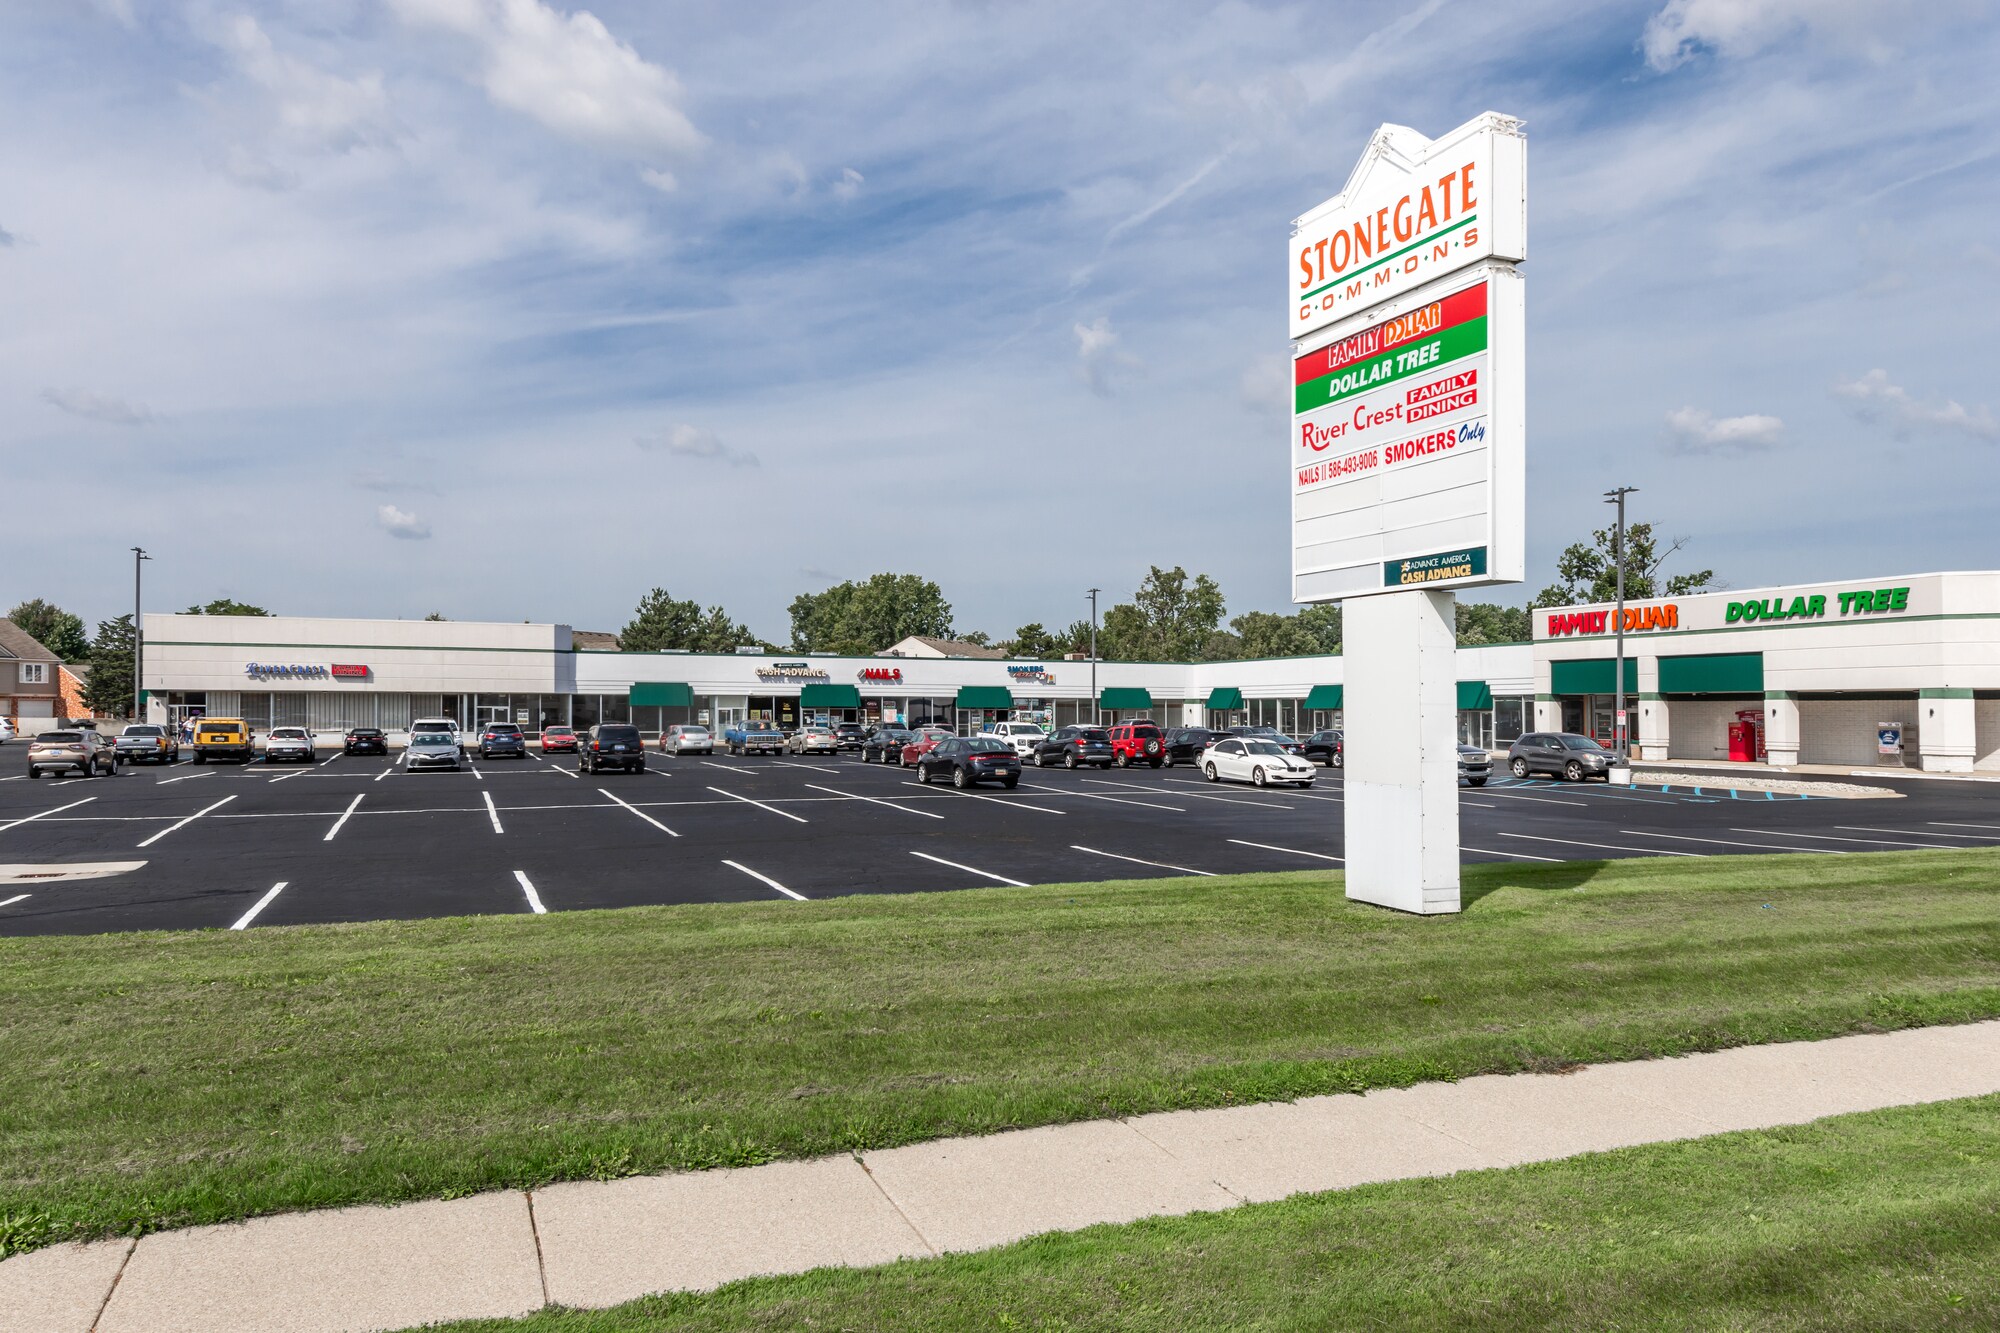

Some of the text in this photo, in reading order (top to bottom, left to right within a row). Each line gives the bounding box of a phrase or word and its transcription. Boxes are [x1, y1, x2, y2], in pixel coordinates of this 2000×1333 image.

[1300, 161, 1477, 289] STONEGATE
[1328, 302, 1441, 368] FAMILY DOLLAR
[1329, 341, 1441, 397] DOLLAR TREE
[1410, 372, 1473, 402] FAMILY
[1410, 392, 1473, 421] DINING
[1302, 402, 1403, 451] River Crest
[1384, 421, 1486, 465] SMOKERS Only
[1298, 466, 1320, 487] NAILS
[1328, 450, 1378, 478] 586-493-9006
[1401, 564, 1471, 584] CASH ADVANCE
[1410, 554, 1471, 569] ADVANCE AMERICA
[1725, 587, 1910, 622] DOLLAR TREE
[1548, 610, 1609, 636] FAMILY
[755, 667, 827, 677] CASH ADVANCE
[865, 668, 901, 680] NAILS
